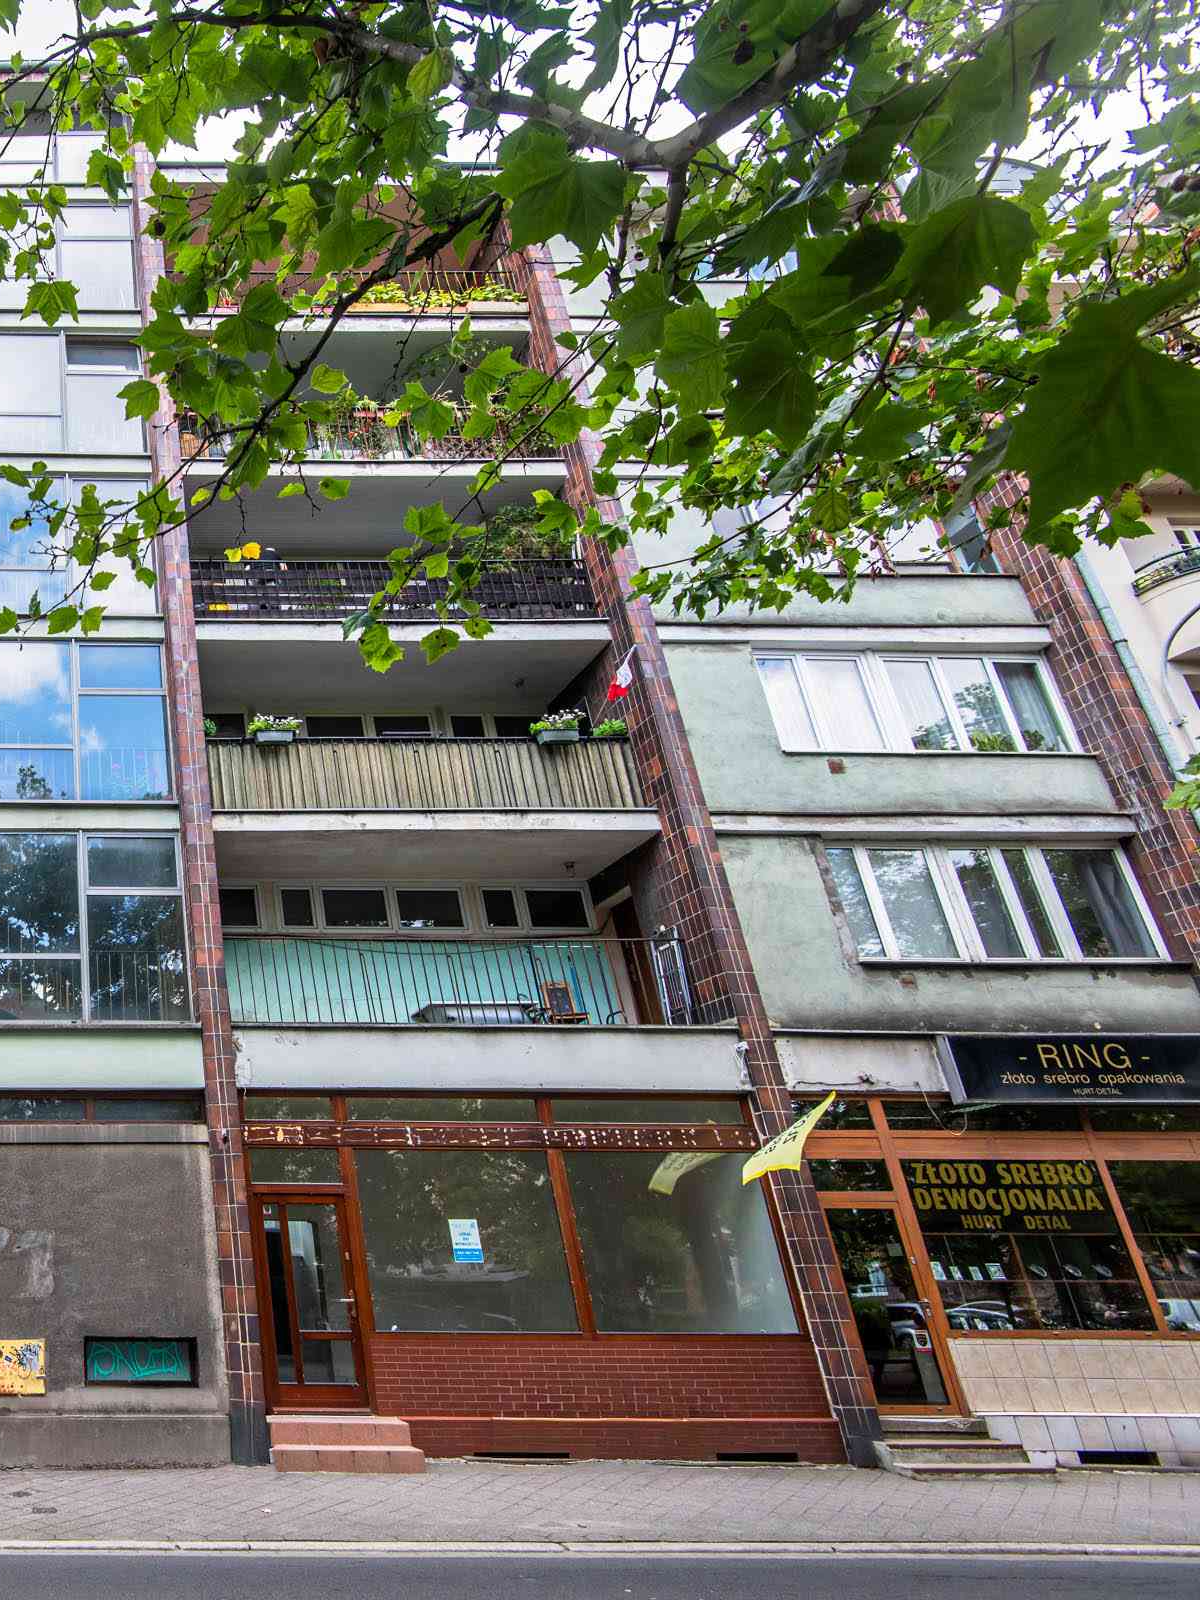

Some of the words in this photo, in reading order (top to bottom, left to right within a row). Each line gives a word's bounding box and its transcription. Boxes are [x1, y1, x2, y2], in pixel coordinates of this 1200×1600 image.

[1036, 1043, 1132, 1069] RING
[1000, 1072, 1036, 1084] złoto
[1043, 1071, 1090, 1084] srebro
[1098, 1071, 1186, 1087] opakowania
[911, 1163, 986, 1184] ZŁOTO
[996, 1163, 1093, 1185] SREBRO
[913, 1188, 1105, 1216] DEWOCJONALIA
[961, 1215, 1002, 1230] HURT
[1024, 1215, 1072, 1230] DETAL
